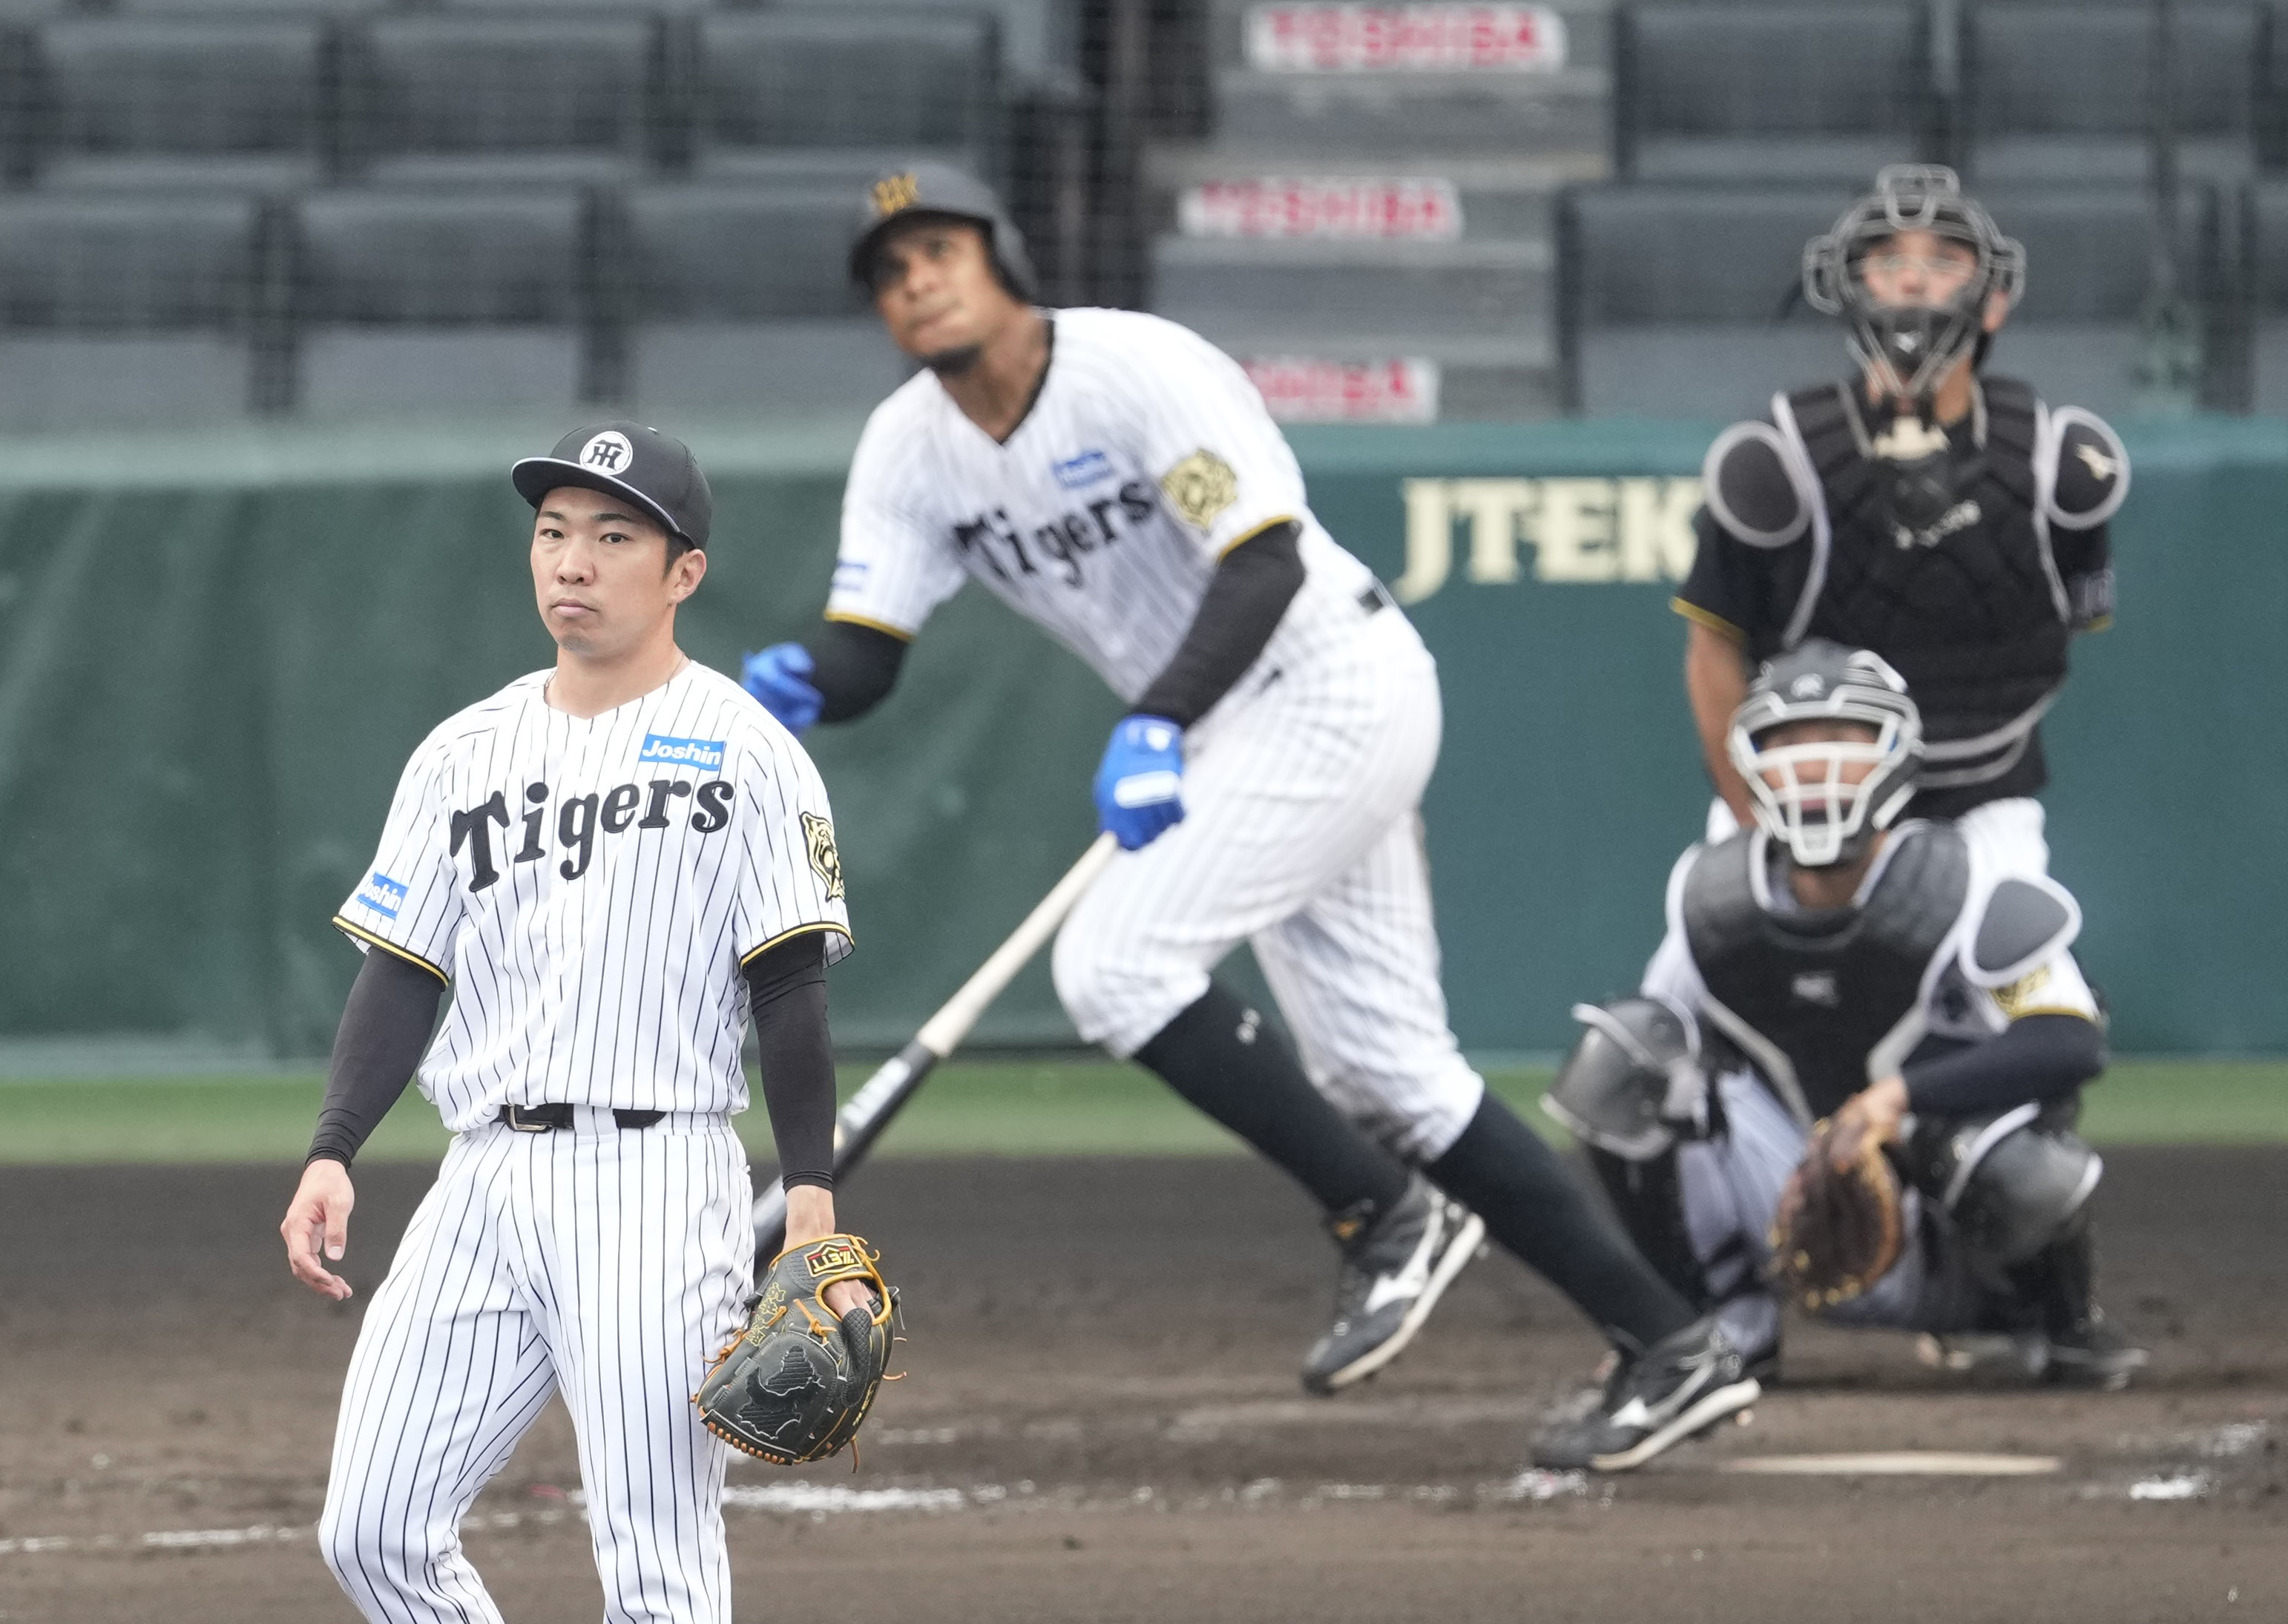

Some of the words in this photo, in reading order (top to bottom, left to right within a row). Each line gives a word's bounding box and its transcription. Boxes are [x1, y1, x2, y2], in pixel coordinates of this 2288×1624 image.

[953, 479, 1154, 589] Tigers
[642, 739, 721, 766] Joshin
[450, 779, 734, 892] Tigers
